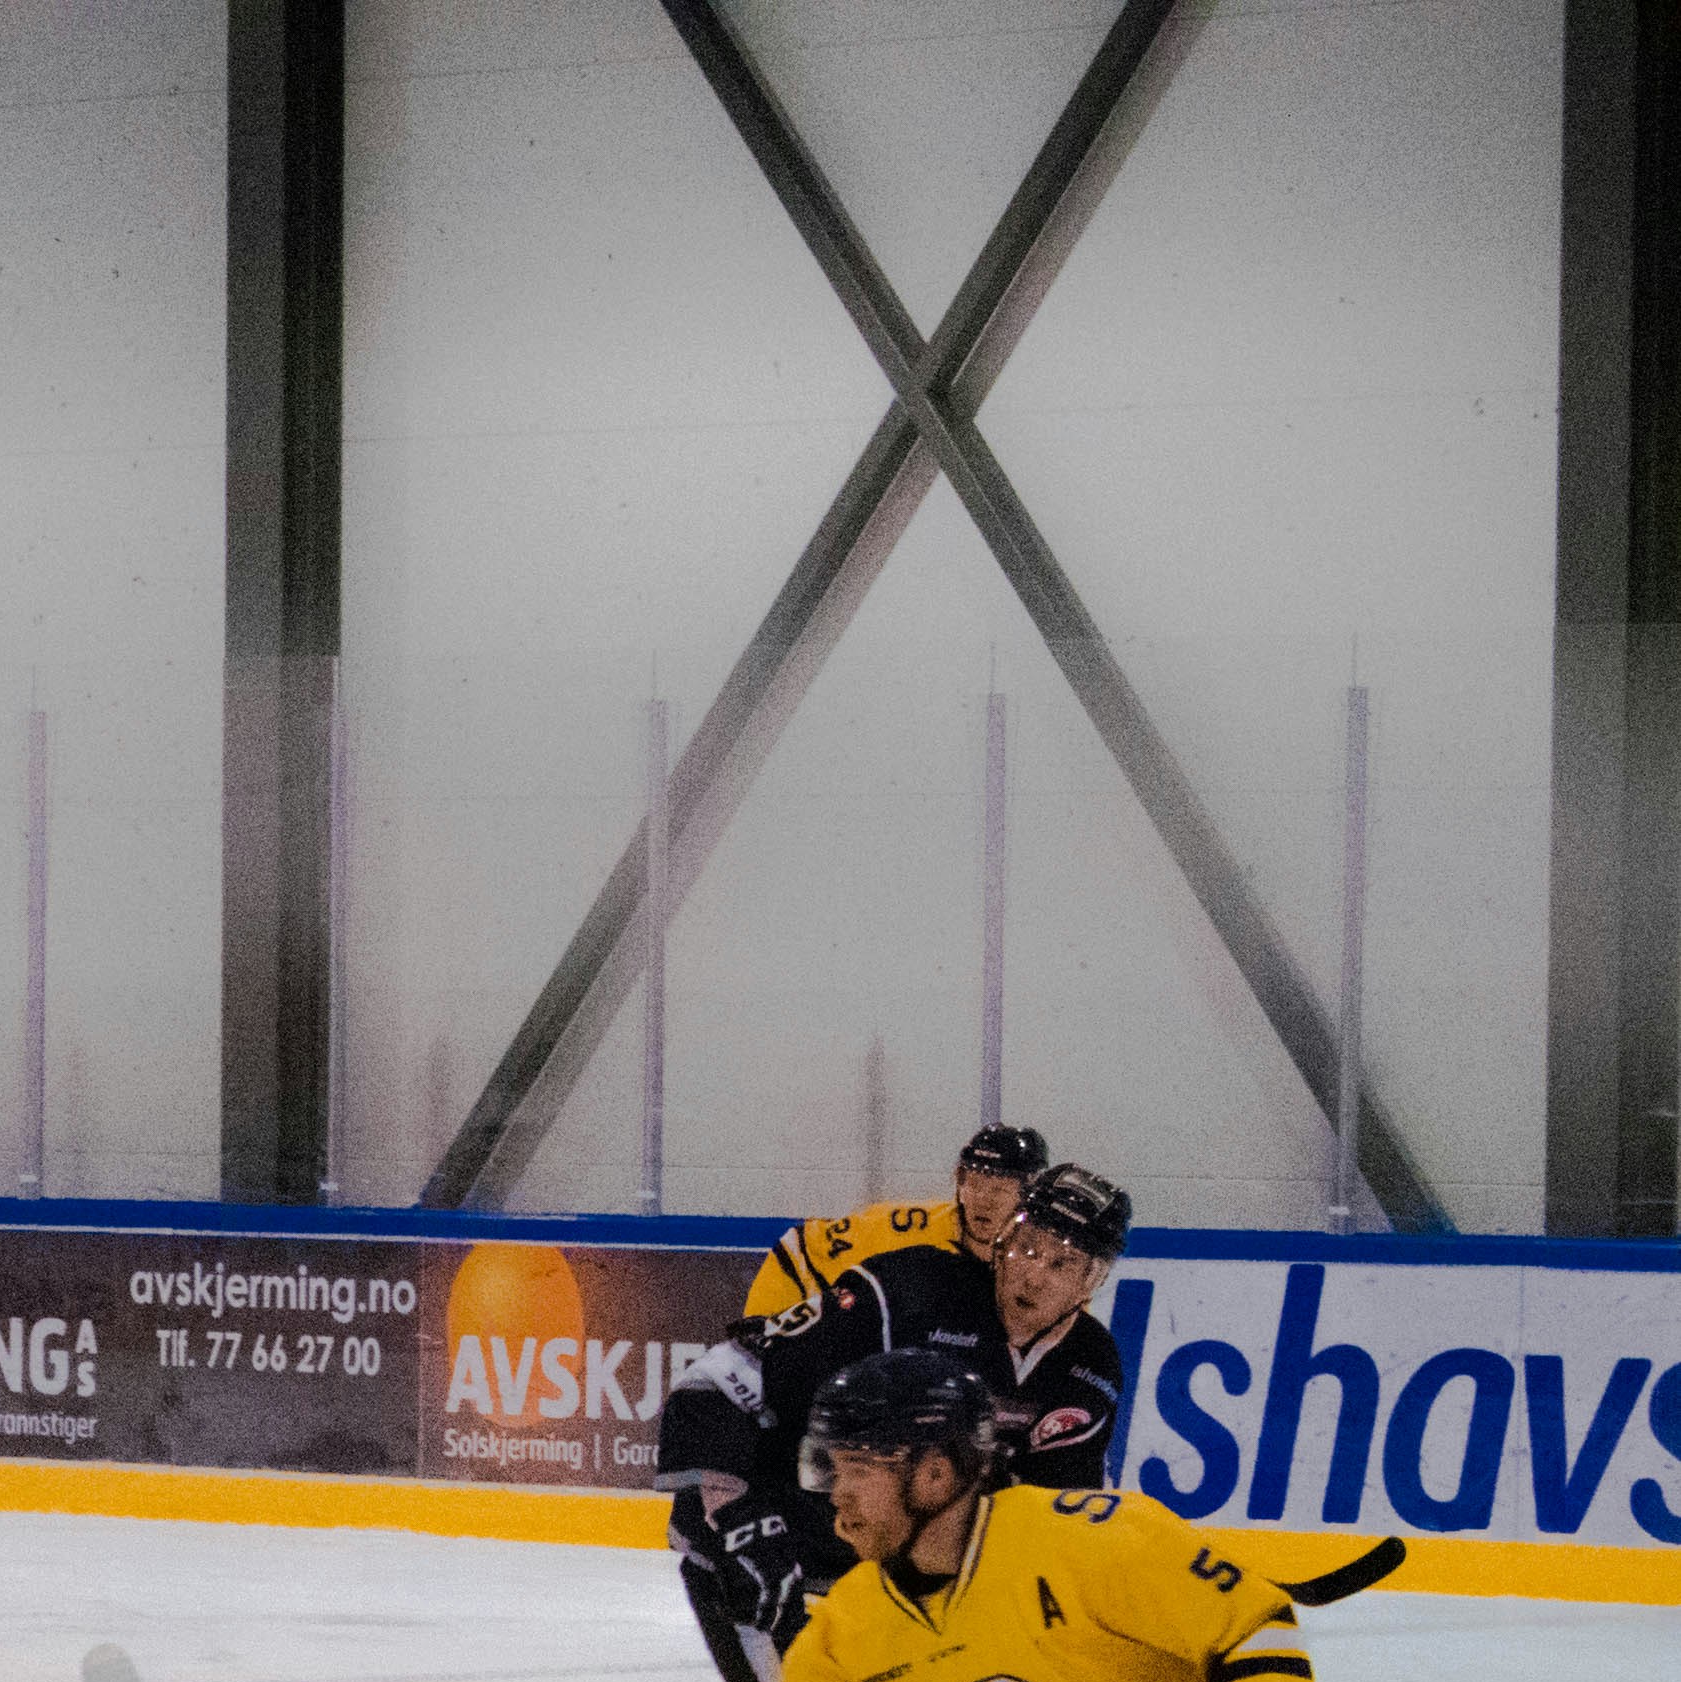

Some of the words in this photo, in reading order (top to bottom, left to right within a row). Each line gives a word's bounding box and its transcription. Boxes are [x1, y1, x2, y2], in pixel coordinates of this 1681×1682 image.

[130, 1261, 417, 1324] avskjerming.no
[206, 1331, 242, 1369] 77
[252, 1333, 287, 1372] 66
[296, 1335, 335, 1373] 27
[343, 1336, 381, 1376] 00
[443, 1428, 583, 1470] Solskjerming
[1188, 1547, 1243, 1594] 5
[1037, 1575, 1067, 1629] A
